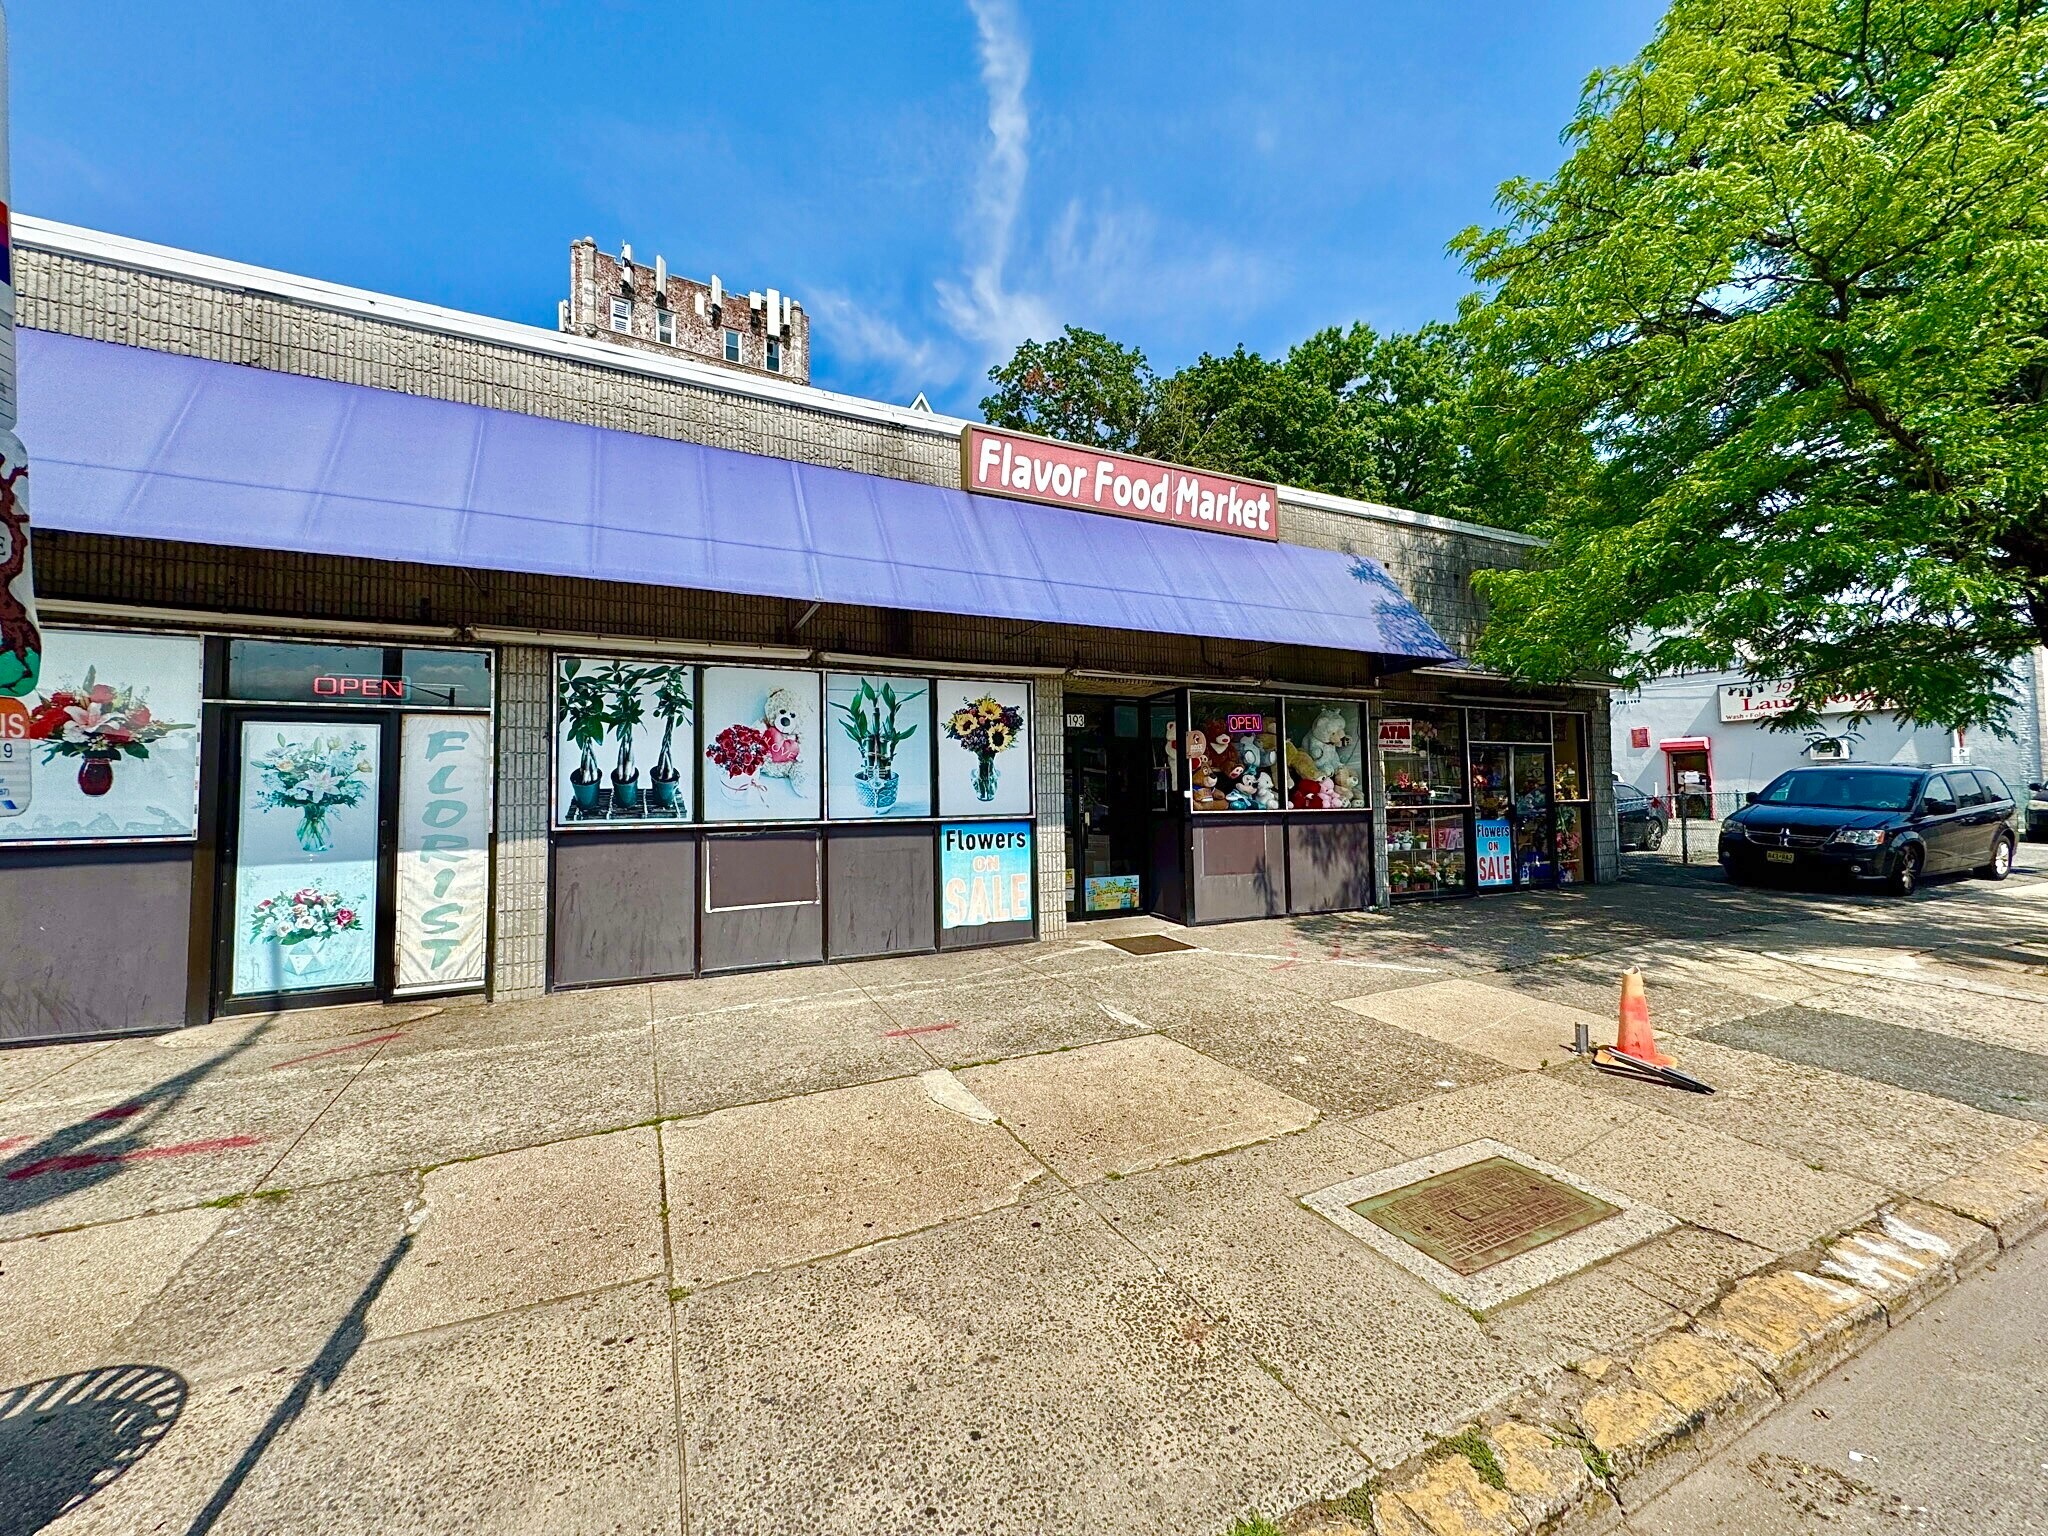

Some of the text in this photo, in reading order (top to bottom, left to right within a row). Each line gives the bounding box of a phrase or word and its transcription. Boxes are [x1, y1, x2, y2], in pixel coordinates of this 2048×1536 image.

[978, 437, 1271, 531] Flavor Food Market
[313, 676, 405, 697] OPEN
[1068, 714, 1084, 727] 193
[1230, 716, 1260, 730] OPEN
[1379, 725, 1410, 739] ATM
[945, 829, 1027, 851] Flowers
[1476, 824, 1510, 838] Flowers
[419, 729, 470, 971] FLORIST
[1488, 841, 1499, 851] ON
[973, 855, 1000, 872] ON
[1478, 855, 1511, 880] SALE
[945, 873, 1029, 924] SALE
